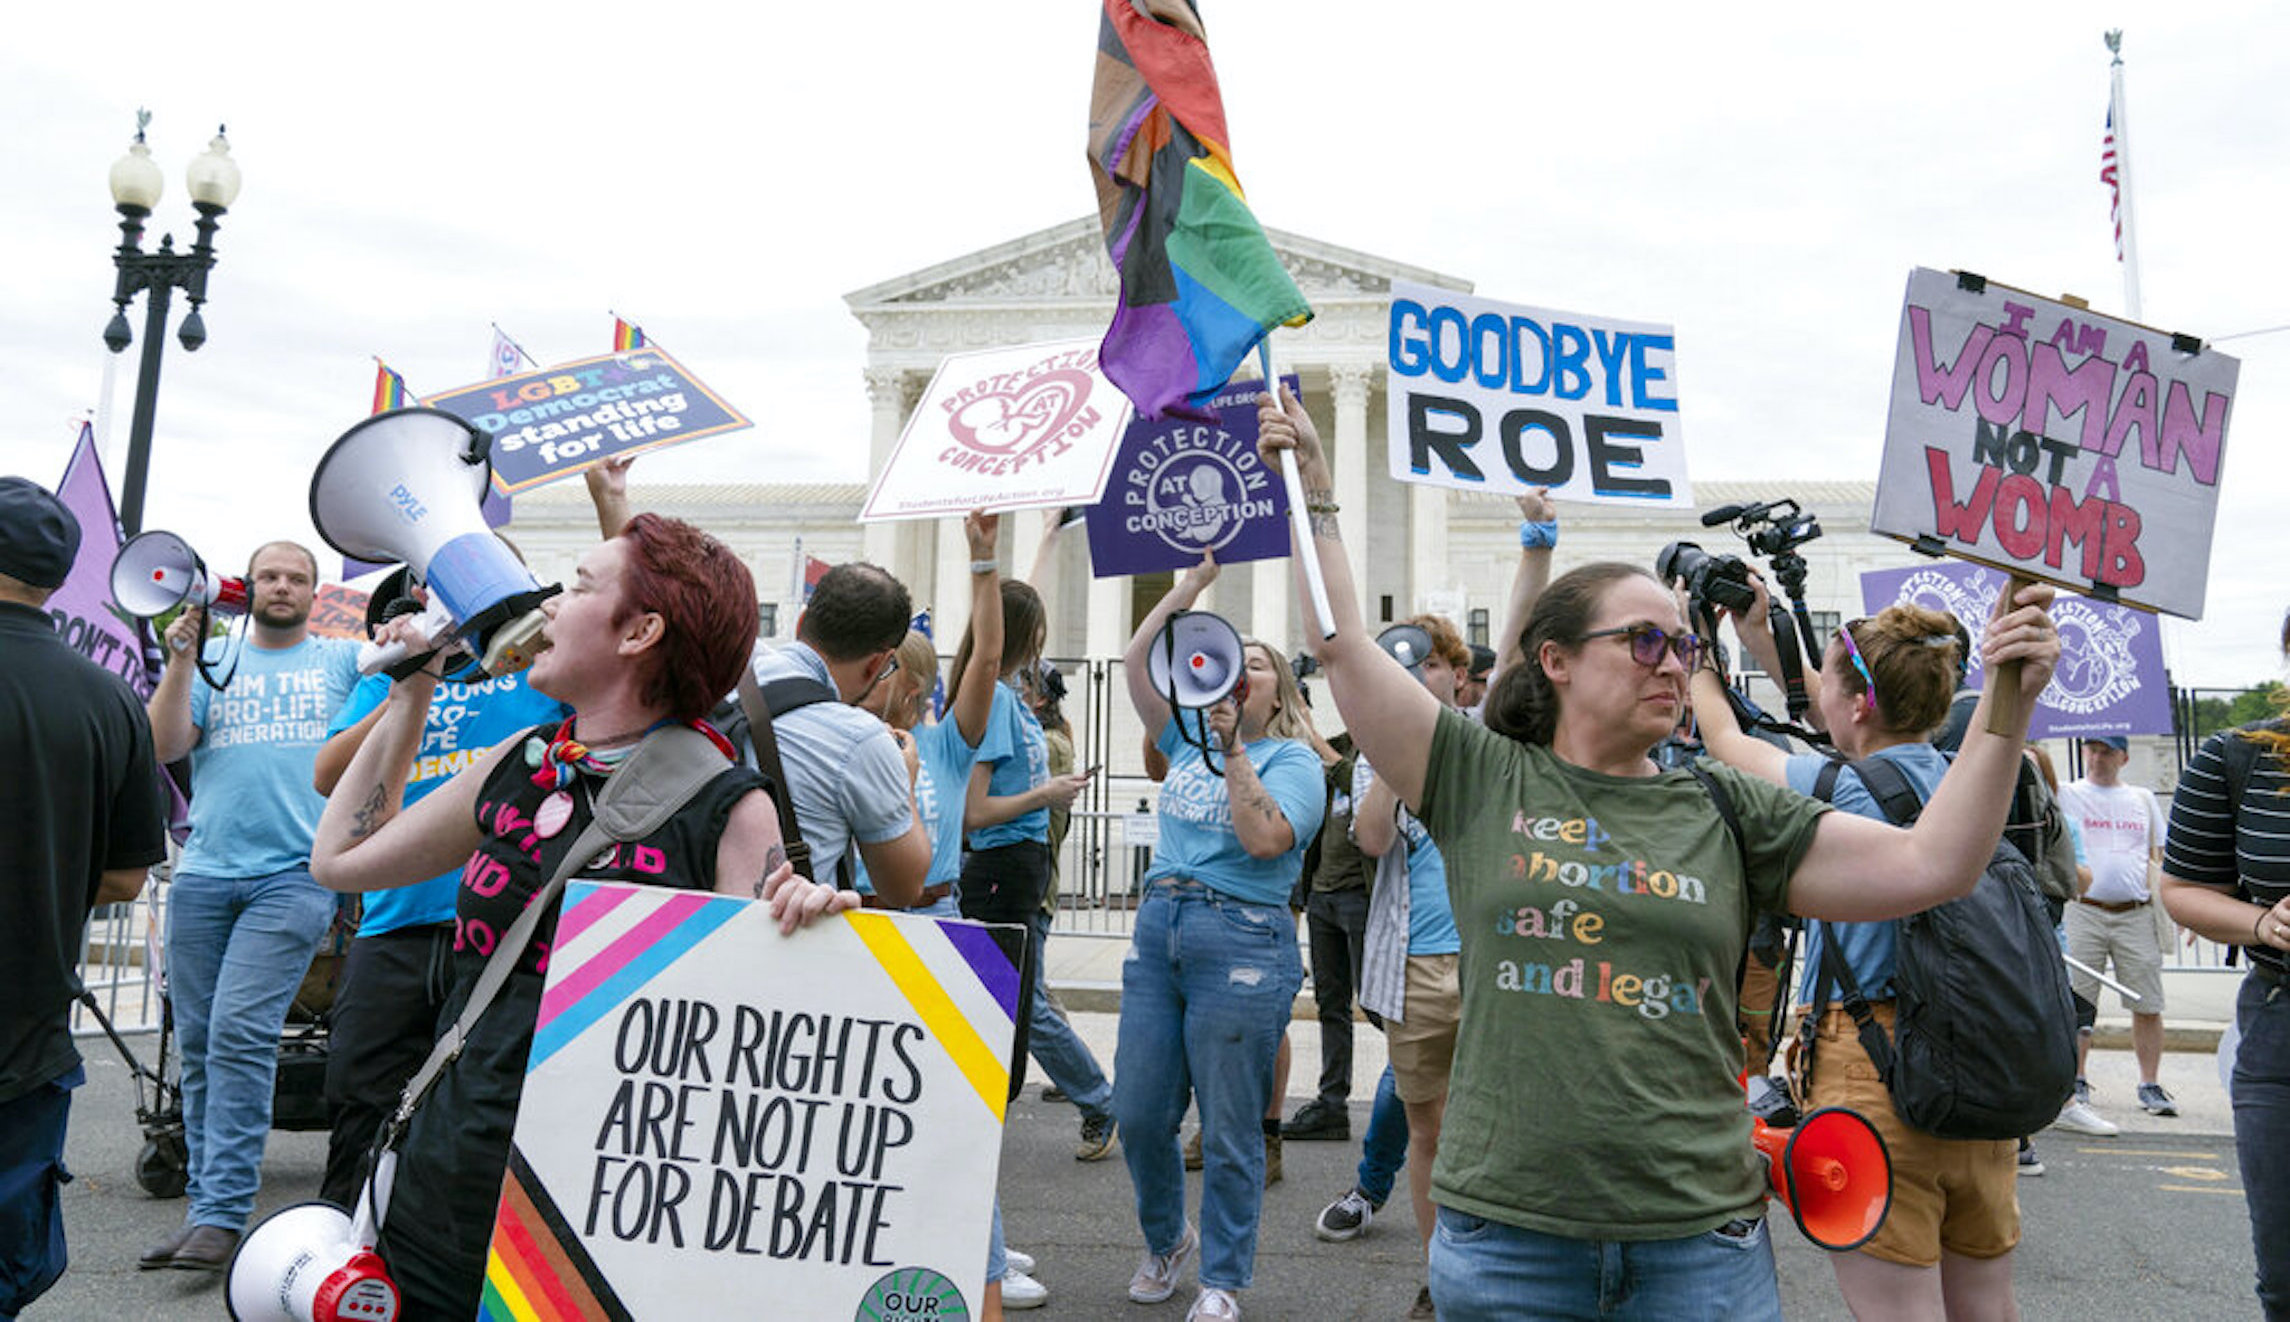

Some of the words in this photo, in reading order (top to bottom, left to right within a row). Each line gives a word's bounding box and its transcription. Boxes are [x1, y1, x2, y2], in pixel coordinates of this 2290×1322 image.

[1389, 298, 1679, 412] GOODBYE
[1998, 300, 2035, 341] I
[2050, 317, 2107, 357] AM
[2122, 340, 2150, 372] A
[472, 371, 679, 433] Democrat
[500, 391, 688, 452] standing
[1908, 304, 2230, 486] WOMAN
[537, 431, 604, 464] for
[607, 413, 682, 442] life
[938, 404, 1102, 476] CONCEPTION
[1126, 426, 1269, 506] PROTECTION
[1406, 391, 1673, 499] ROE
[1973, 415, 2079, 485] NOT
[2085, 454, 2121, 503] A
[389, 484, 429, 523] PYLE
[1126, 499, 1275, 533] CONCEPTION
[1159, 475, 1188, 496] AT
[1924, 445, 2145, 588] WOMB
[209, 692, 328, 730] PRO-LIFE
[276, 667, 326, 696] THE
[209, 720, 328, 749] GENERATION
[1510, 809, 1611, 852] keep
[1496, 899, 1606, 945] safe
[1496, 958, 1586, 999] and
[614, 997, 719, 1084] OUR
[724, 1004, 925, 1106] RIGHTS
[595, 1078, 712, 1163] ARE
[711, 1089, 831, 1175] NOT
[836, 1104, 915, 1182] UP
[583, 1154, 693, 1249] FOR
[704, 1168, 905, 1267] DEBATE
[885, 1293, 939, 1316] OUR
